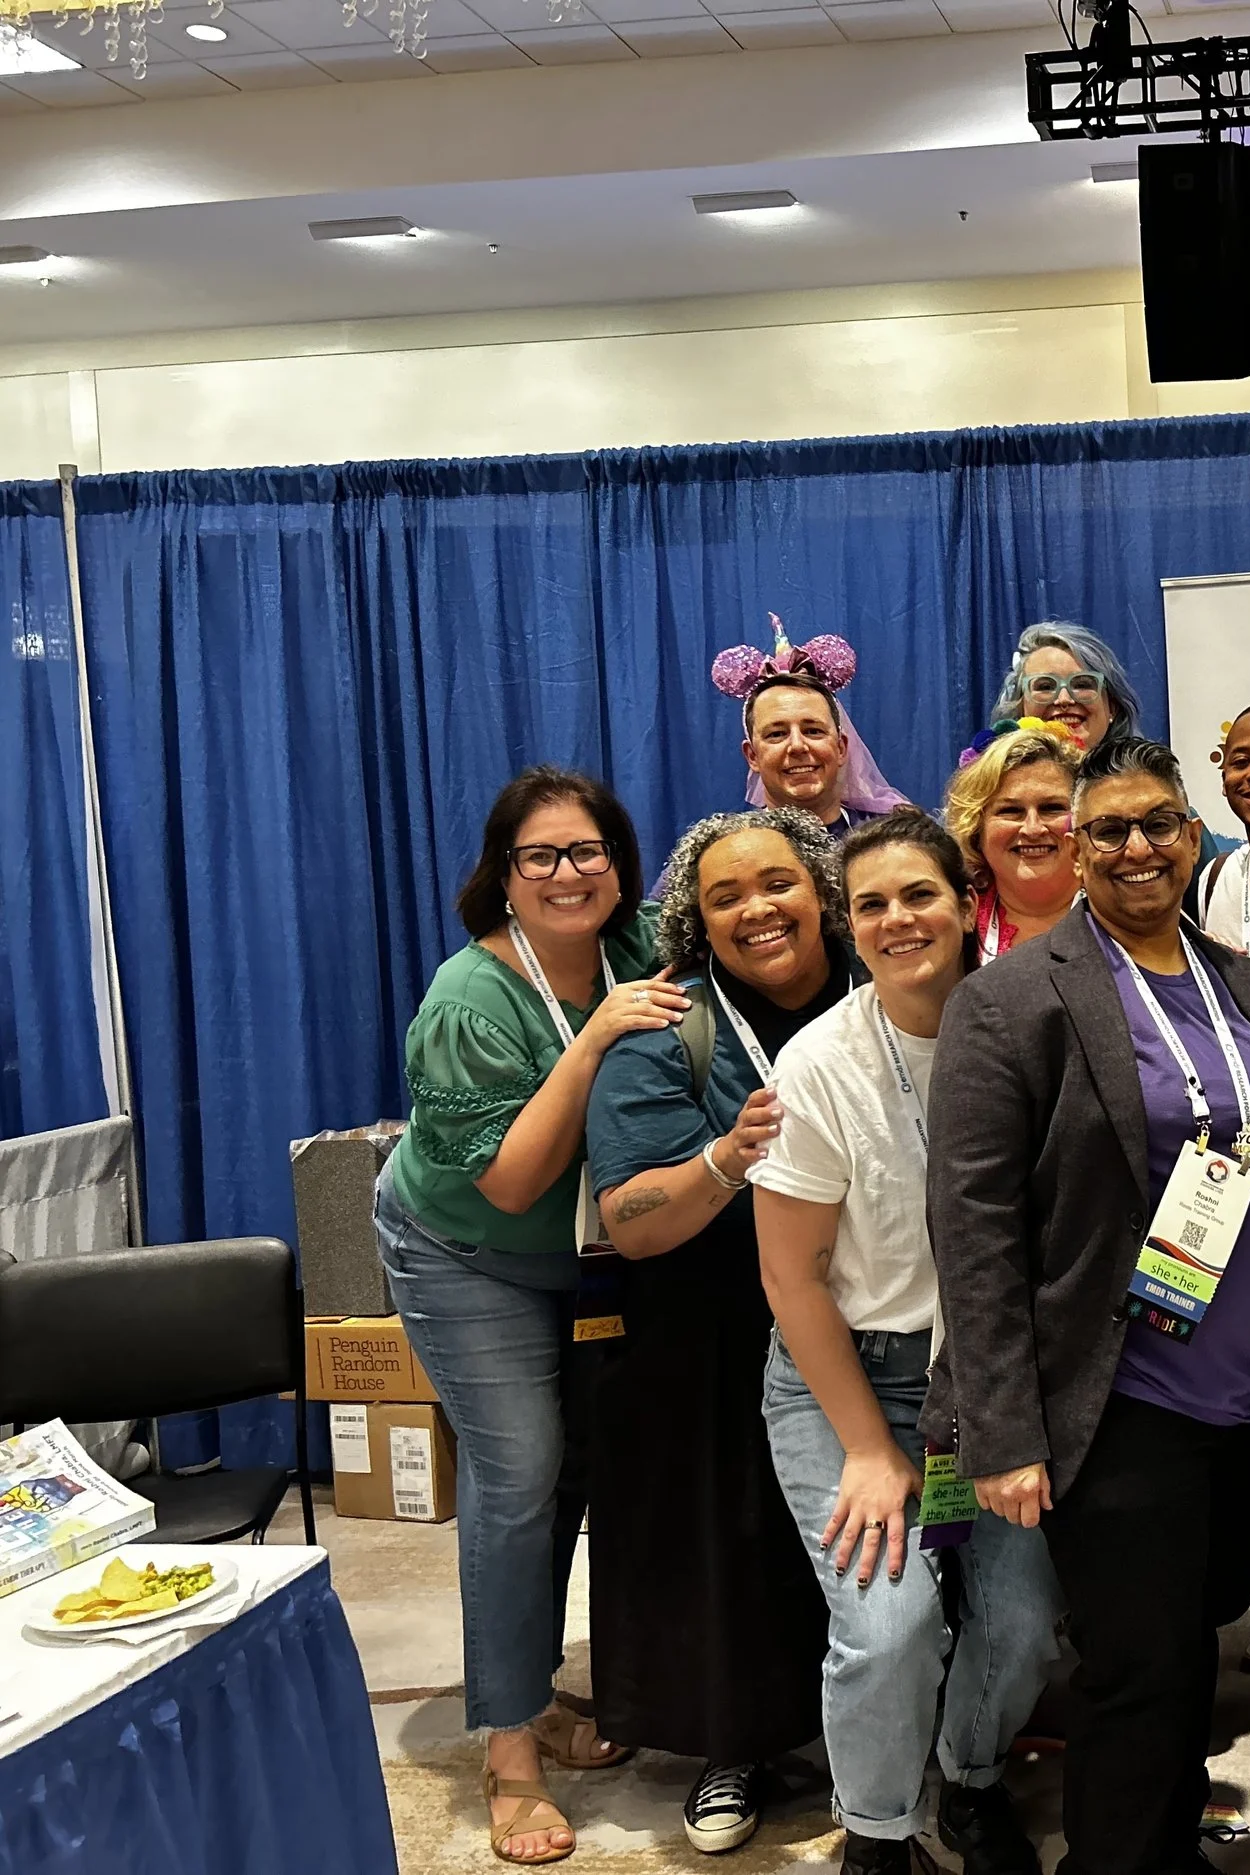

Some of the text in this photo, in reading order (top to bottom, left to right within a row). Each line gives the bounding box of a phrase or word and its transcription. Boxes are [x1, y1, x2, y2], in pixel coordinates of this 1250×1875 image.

[1195, 1190, 1219, 1206] Roshni
[1151, 1264, 1199, 1292] she her
[1145, 1281, 1196, 1312] EMDR TRAINER
[329, 1337, 400, 1357] Penguin
[332, 1355, 402, 1372] Random
[334, 1374, 386, 1391] House
[932, 1486, 970, 1500] she her
[926, 1506, 976, 1522] they them
